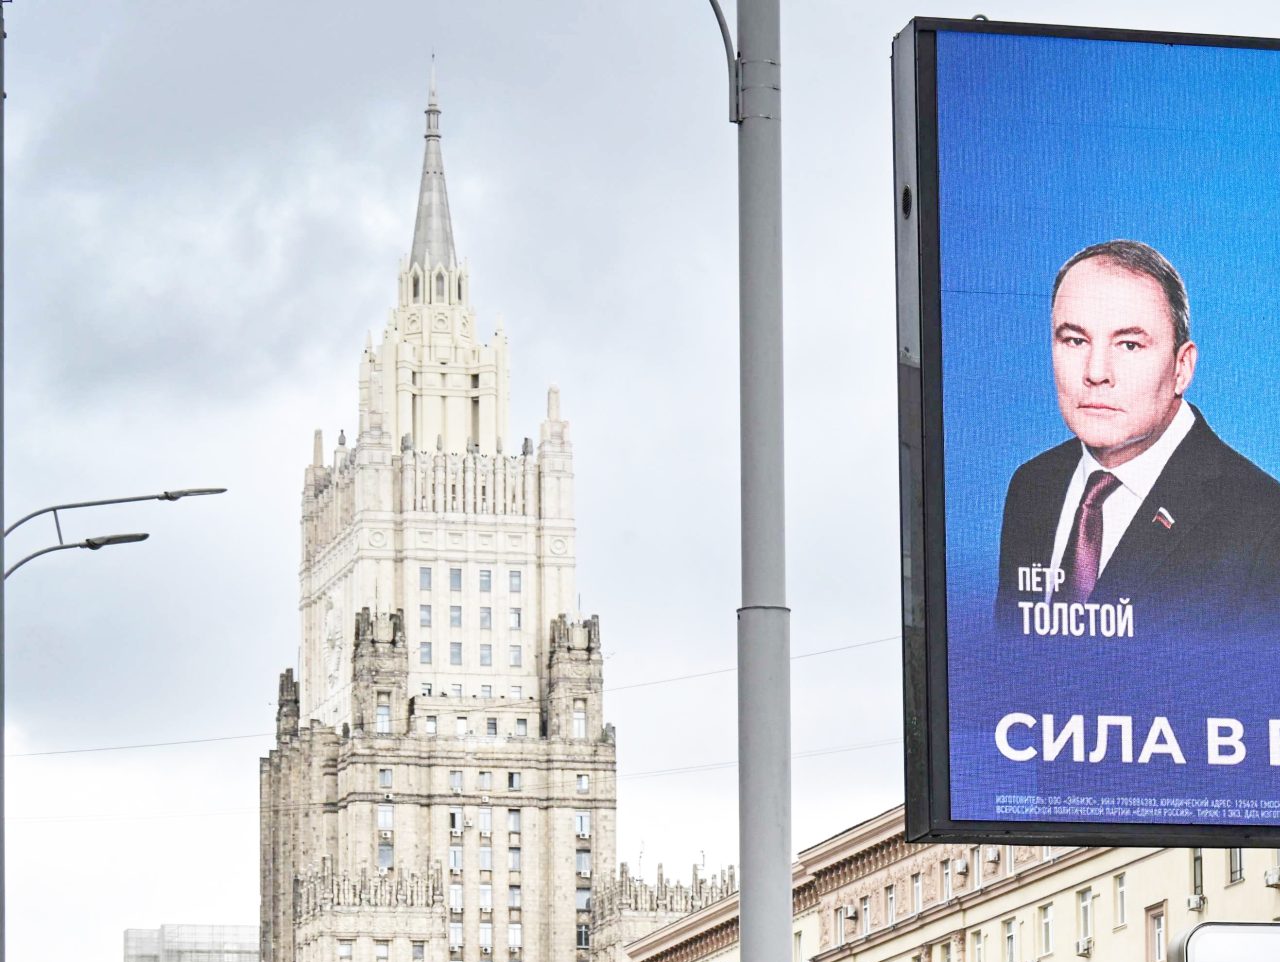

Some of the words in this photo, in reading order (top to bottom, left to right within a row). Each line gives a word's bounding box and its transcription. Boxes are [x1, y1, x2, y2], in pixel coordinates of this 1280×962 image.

[1017, 563, 1066, 593] ПЁТР
[1017, 598, 1135, 638] ТОЛСТОЙ
[994, 711, 1187, 765] СИЛА
[1206, 717, 1248, 766] В
